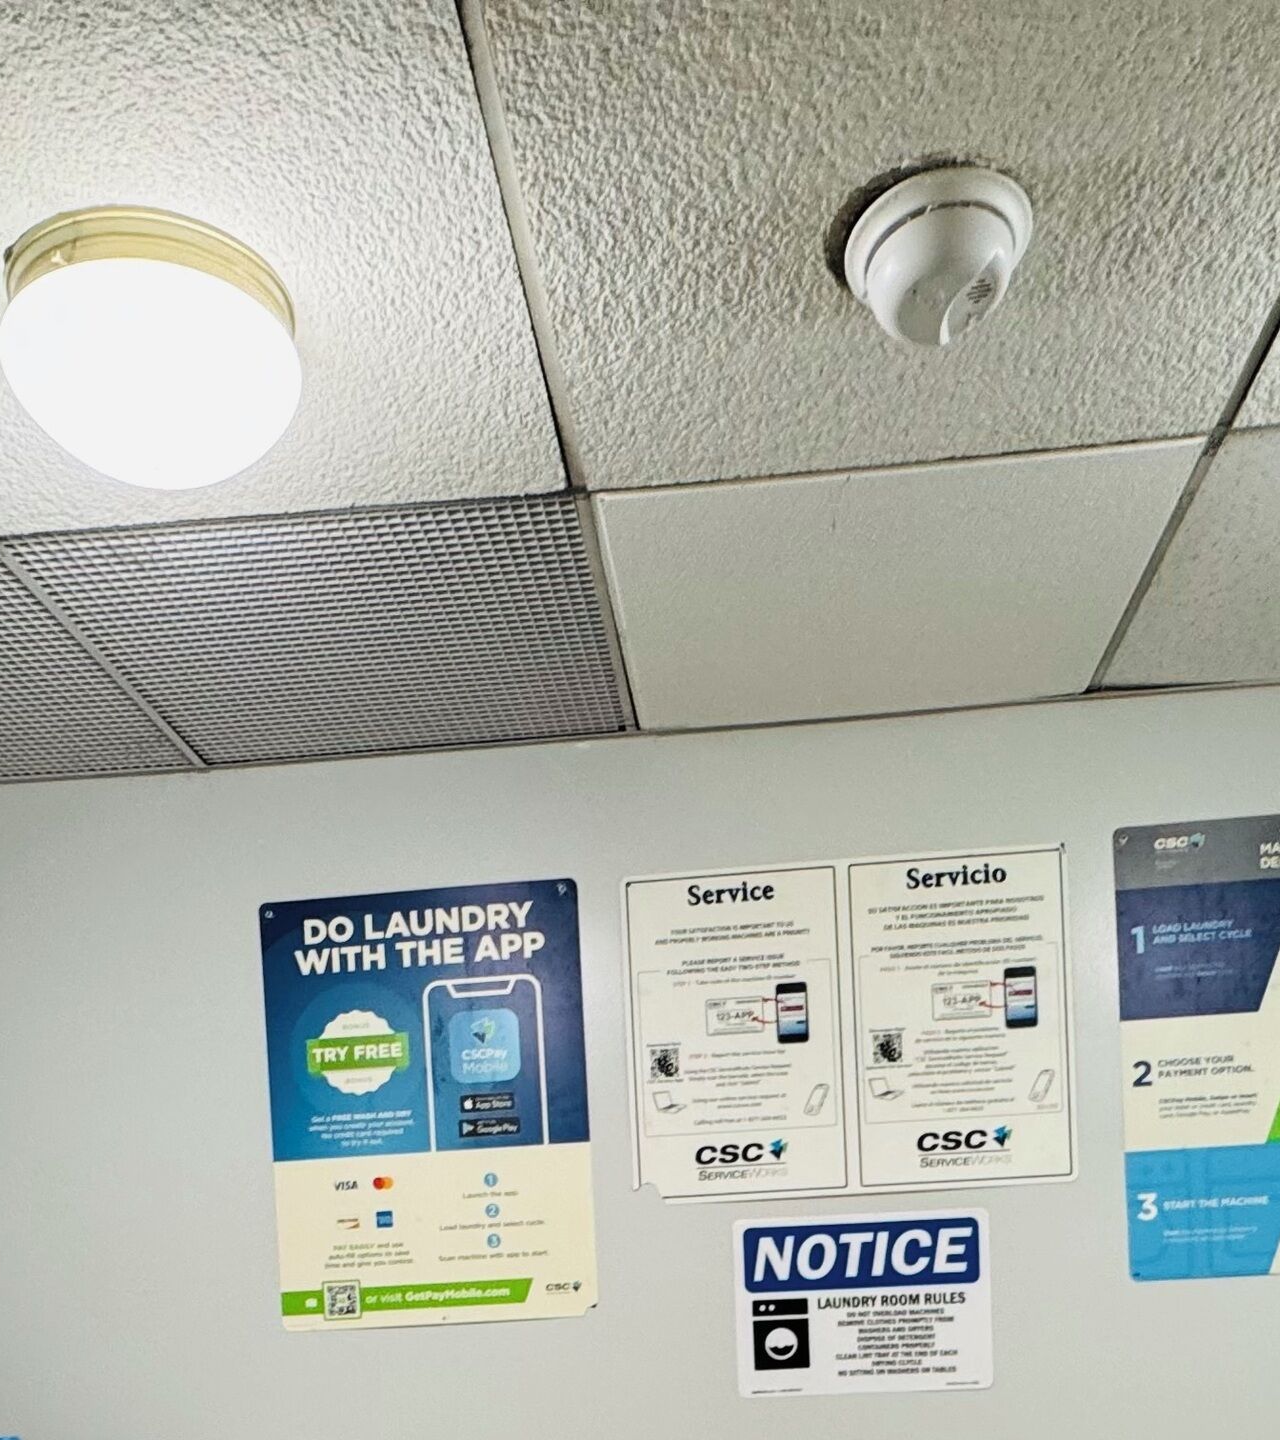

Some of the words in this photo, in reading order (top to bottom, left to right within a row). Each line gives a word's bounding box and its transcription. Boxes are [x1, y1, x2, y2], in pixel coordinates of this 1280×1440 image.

[1154, 835, 1189, 850] CSC
[906, 863, 1007, 890] Servicio
[687, 881, 775, 906] Service
[303, 916, 354, 945] DO
[364, 901, 534, 941] LAUNDRY
[1152, 921, 1181, 935] LOAD
[1182, 918, 1234, 932] LAUNDRY
[1131, 925, 1146, 954] 1
[1178, 930, 1217, 944] SELECT
[1218, 928, 1253, 940] CYCLE
[294, 944, 386, 976] WITH
[395, 937, 465, 969] THE
[474, 932, 545, 962] APP
[312, 1046, 349, 1063] TRY
[354, 1042, 403, 1060] FREE
[1158, 1057, 1201, 1067] CHOOSE
[1132, 1060, 1153, 1087] 2
[1158, 1067, 1208, 1078] PAYMENT
[917, 1130, 988, 1152] CSC
[695, 1143, 764, 1165] CSC
[334, 1181, 358, 1191] VISA
[1137, 1192, 1158, 1221] 3
[753, 1227, 973, 1282] NOTICE
[380, 1292, 402, 1303] visit
[404, 1287, 510, 1303] GetPayMobile.com
[545, 1283, 570, 1292] CSC
[817, 1296, 877, 1310] LAUNDRY
[881, 1293, 920, 1306] ROOM
[924, 1291, 966, 1305] RULES
